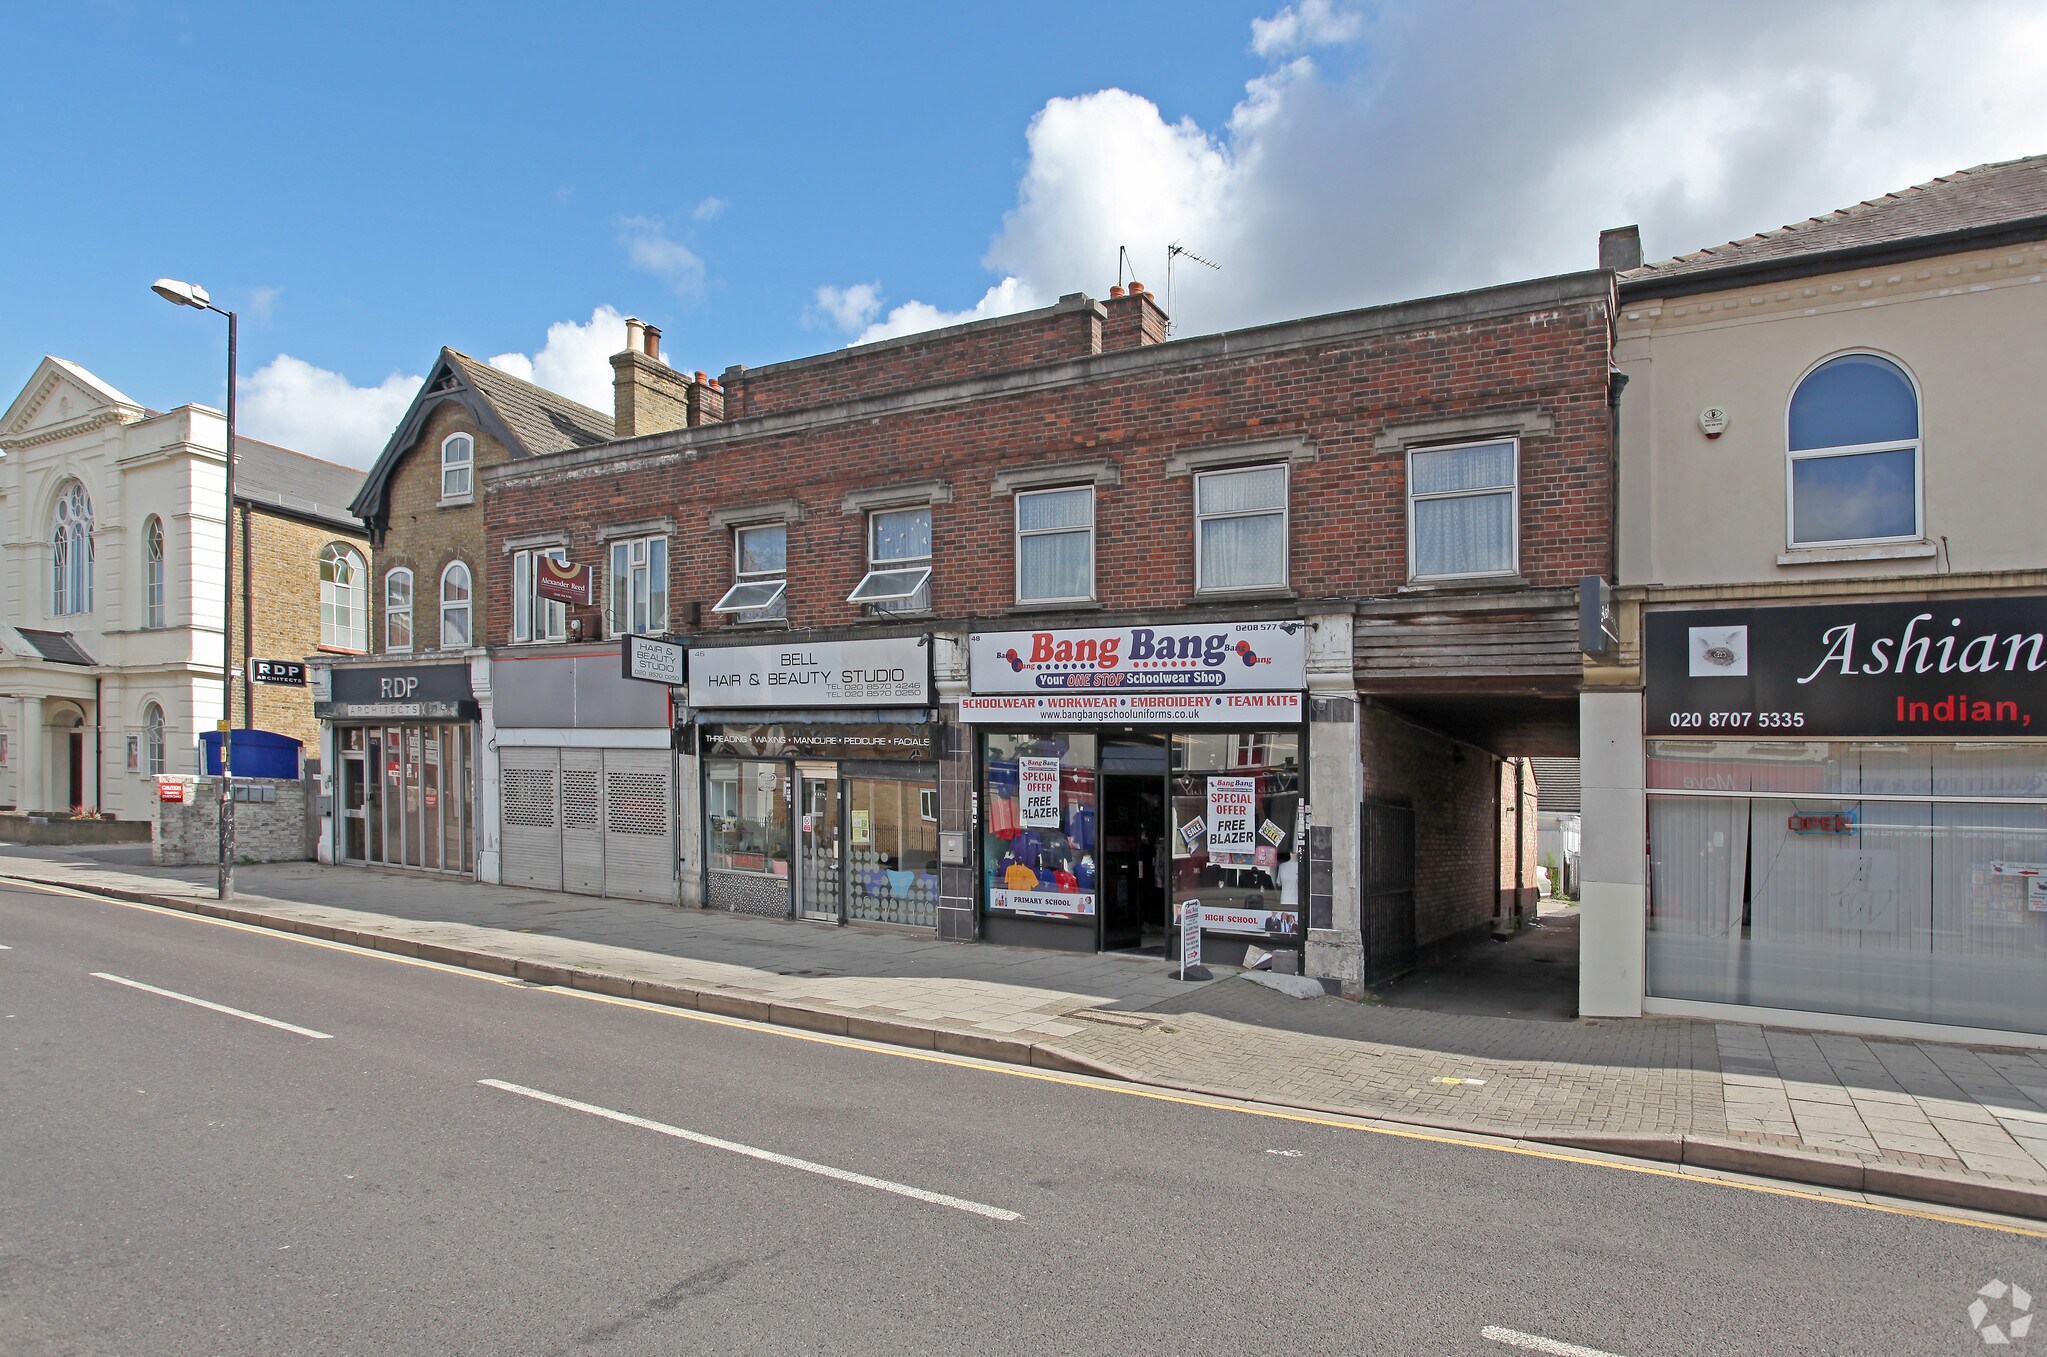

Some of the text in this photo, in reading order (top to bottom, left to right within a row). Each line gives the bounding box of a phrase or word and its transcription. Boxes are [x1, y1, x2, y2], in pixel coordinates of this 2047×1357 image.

[541, 577, 570, 588] Alexander
[571, 583, 586, 591] Reed
[1236, 624, 1258, 632] 0208
[639, 643, 662, 653] HAIR
[1029, 629, 1228, 669] Bang Bang
[1796, 613, 2047, 684] Ashian
[637, 651, 676, 664] BEAUTY
[781, 653, 818, 666] BELL
[258, 663, 299, 676] RDP
[639, 660, 674, 672] STUDIO
[256, 675, 303, 683] ARCHITECTS
[708, 668, 904, 687] HAIR & BEAUTY STUDIO
[1040, 671, 1223, 687] Your ONE STOP Schoolwear Shop
[381, 677, 419, 698] RDP
[962, 695, 1298, 708] SCHOOLWEAR WORKWEAR EMBROIDERY TEAM KITS
[350, 705, 418, 714] ARCHITECTS
[1040, 708, 1200, 721] www.bangbangschooluniforms.co.uk
[1897, 695, 2031, 726] Indian,
[1670, 712, 1805, 727] 020 8707 5335
[705, 735, 748, 743] THREADING
[754, 736, 786, 744] WAXING
[844, 737, 886, 745] PEDICURE
[893, 738, 930, 746] FACIALS
[1022, 772, 1057, 781] SPECIAL
[1027, 782, 1053, 792] OFFER
[1028, 796, 1051, 807] FREE
[1211, 793, 1252, 803] SPECIAL
[1022, 807, 1058, 819] BLAZER
[1216, 805, 1246, 815] OFFER
[1218, 820, 1245, 831] FREE
[1788, 814, 1854, 832] OPEN
[1186, 823, 1202, 837] SALE
[1263, 827, 1280, 843] SALE
[1210, 832, 1254, 844] BLAZER
[1014, 896, 1071, 906] PRIMARY SCHOOL
[1205, 914, 1224, 922] HIGH
[1227, 915, 1258, 924] SCHOOL
